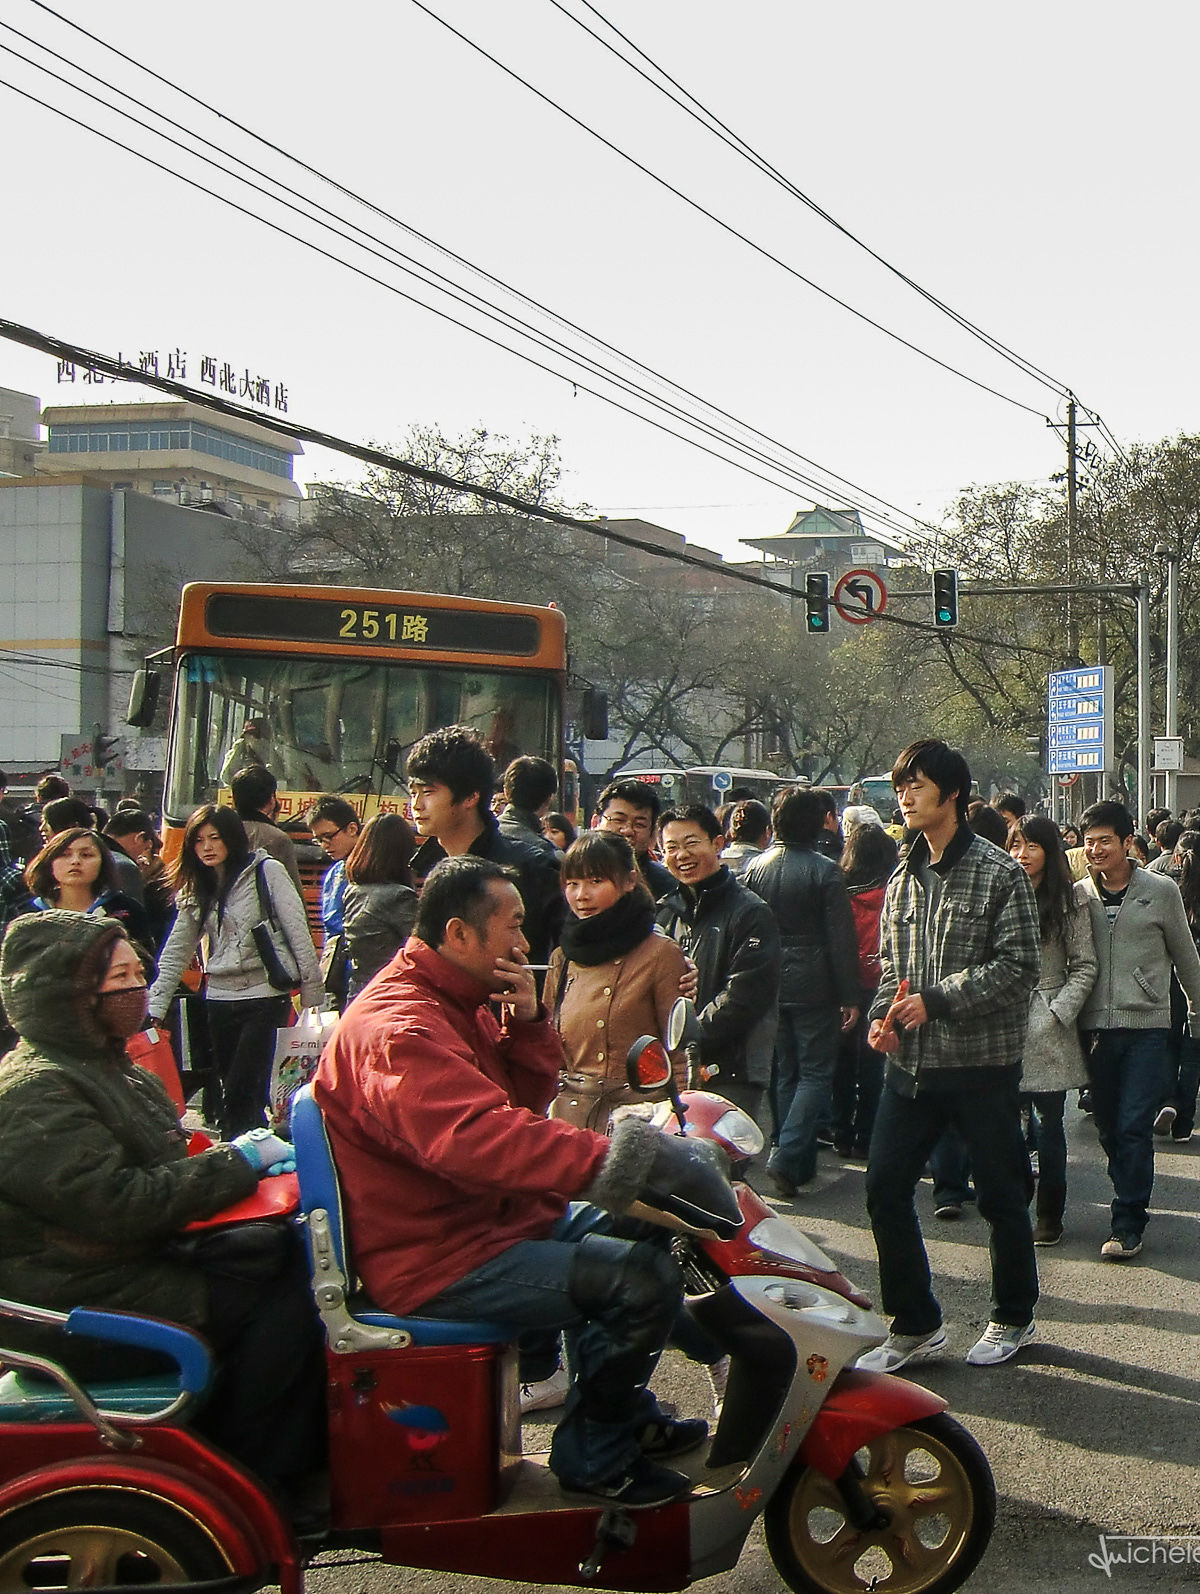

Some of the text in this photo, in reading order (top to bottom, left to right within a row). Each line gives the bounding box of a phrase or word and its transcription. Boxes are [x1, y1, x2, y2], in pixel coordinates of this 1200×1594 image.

[201, 354, 289, 413] 西北大酒店
[339, 608, 429, 643] 251路
